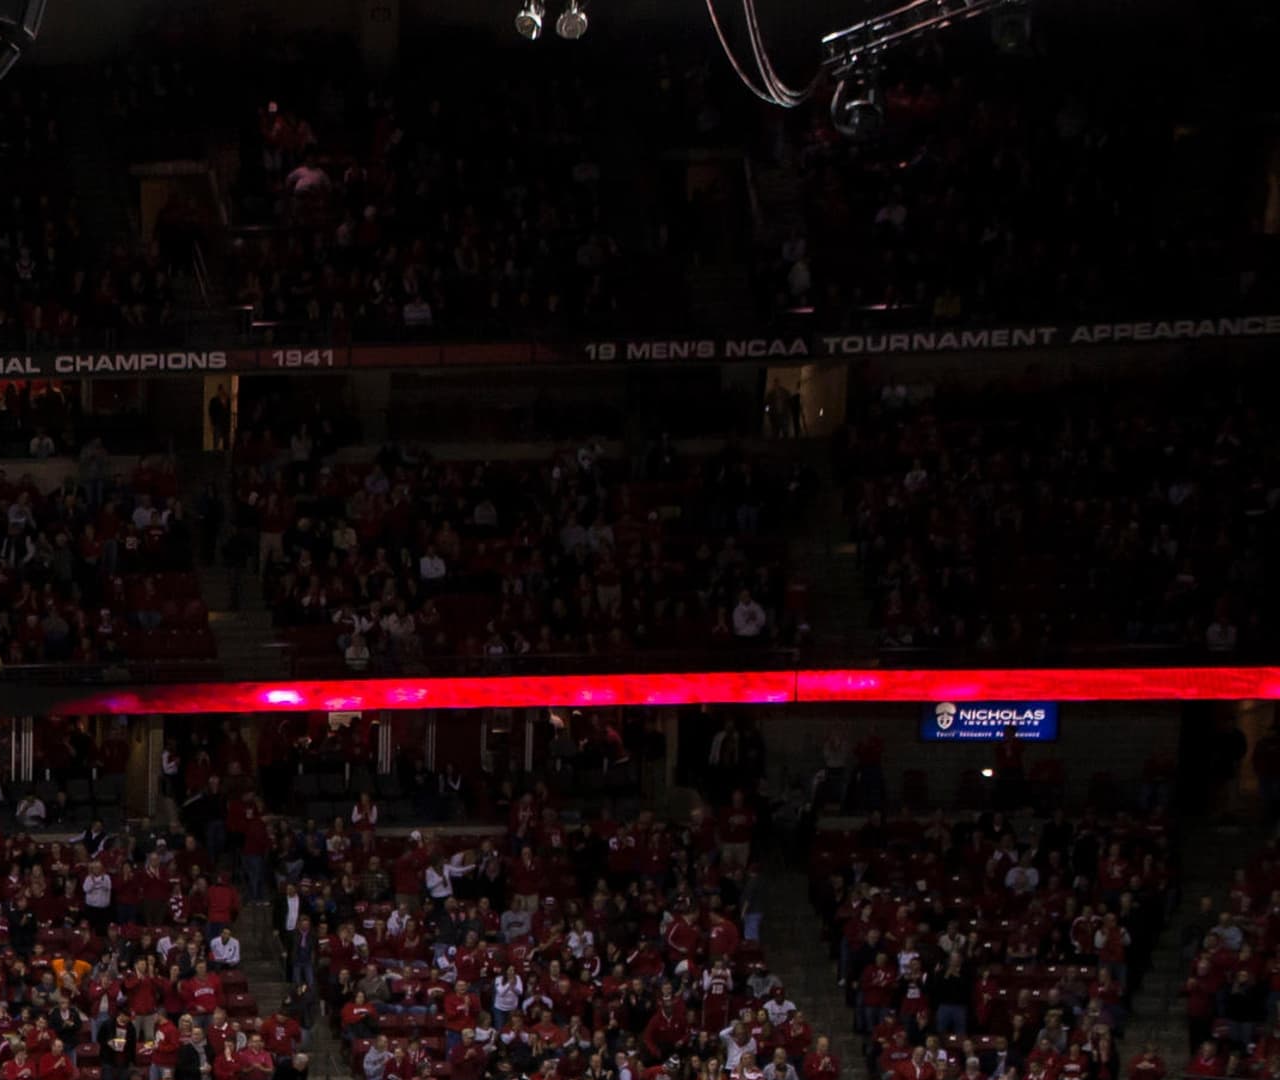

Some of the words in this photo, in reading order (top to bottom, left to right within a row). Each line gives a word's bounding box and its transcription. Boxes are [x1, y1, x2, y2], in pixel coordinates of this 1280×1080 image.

[584, 342, 616, 361] 19
[626, 337, 714, 361] MEN'S
[724, 336, 809, 358] NCAA
[823, 327, 1057, 355] TOURNAMENT
[55, 351, 227, 373] CHAMPIONS
[271, 349, 335, 368] 1941
[959, 709, 1046, 721] NICHOLAS
